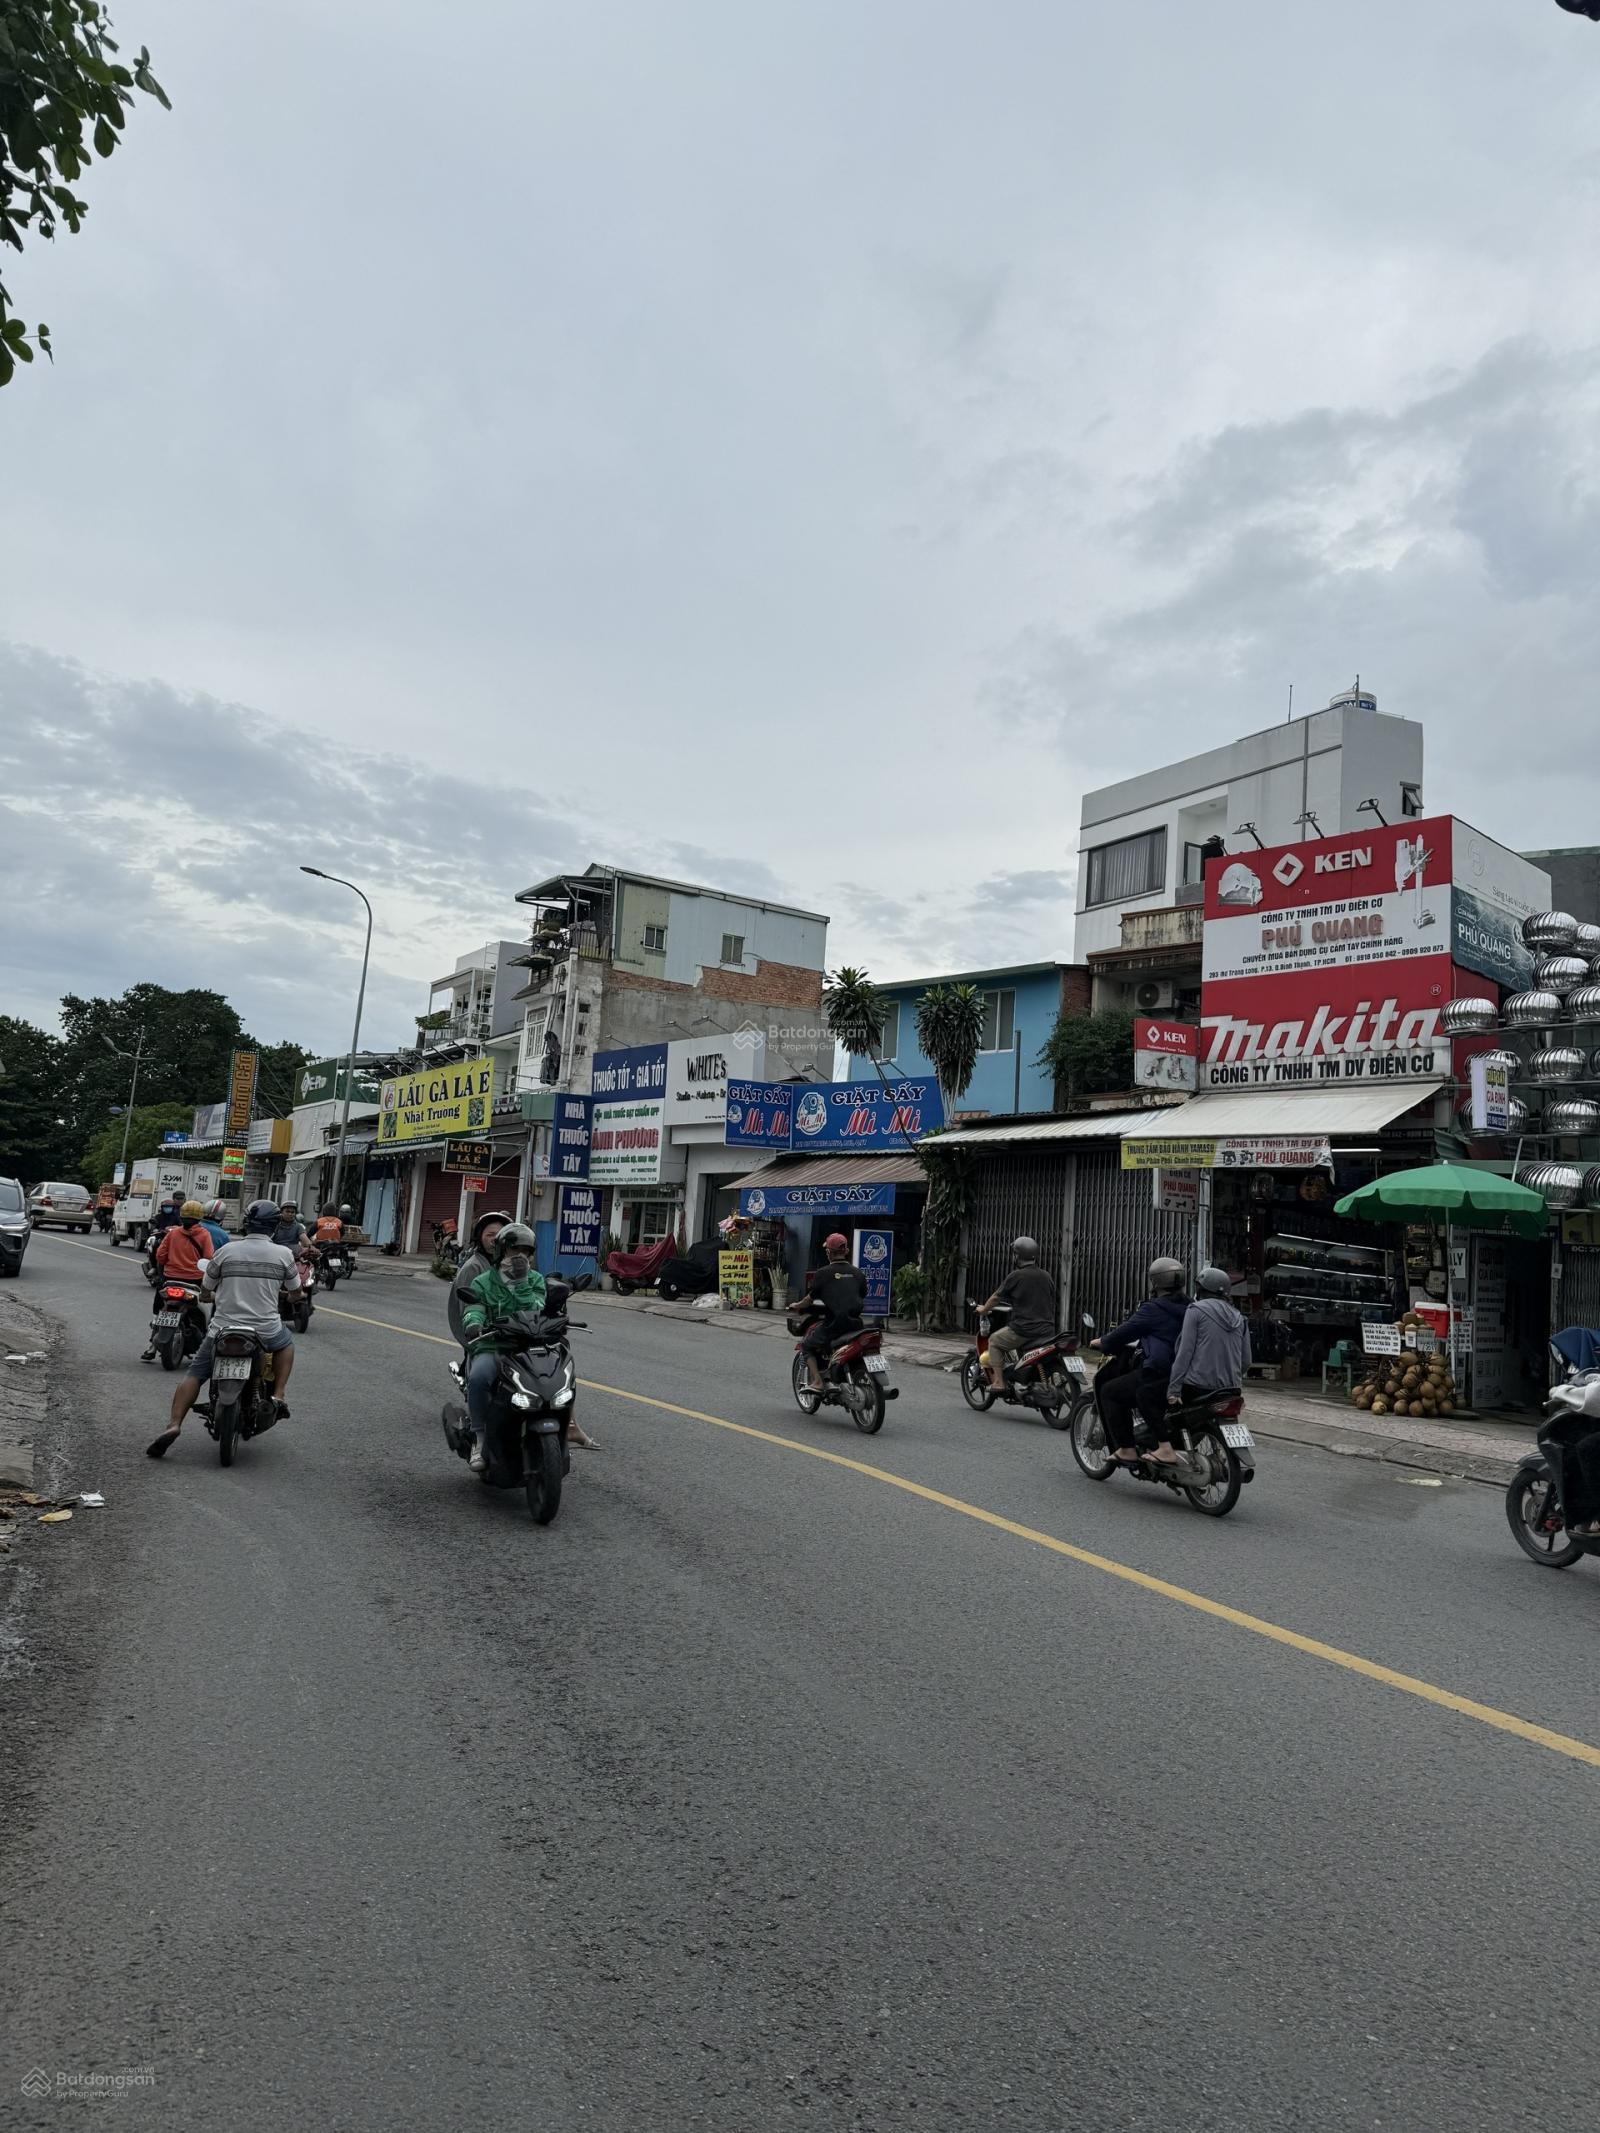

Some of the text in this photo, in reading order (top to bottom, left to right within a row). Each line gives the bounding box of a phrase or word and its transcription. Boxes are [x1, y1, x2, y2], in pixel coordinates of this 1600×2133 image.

[1314, 847, 1372, 875] KEN
[1261, 912, 1283, 924] CÔNG
[1285, 910, 1295, 921] TY
[1297, 907, 1318, 919] TNHH
[1320, 905, 1333, 916] TM
[1335, 903, 1346, 914] DV
[1371, 897, 1383, 908] CƠ
[1311, 914, 1384, 944] QUANG
[1268, 951, 1284, 961] MUA
[1347, 941, 1360, 951] TAY
[1480, 932, 1512, 960] QUANG
[1164, 1031, 1187, 1044] KEN
[594, 1062, 616, 1092] THUỐC
[618, 1060, 630, 1090] TỐT
[636, 1060, 649, 1088] GIÁ
[651, 1056, 665, 1087] TỐT
[1210, 1052, 1434, 1084] CÔNG TY TNHH TM DV ĐIỆN CƠ
[398, 1063, 491, 1108] LẨU GÀ LÁ É
[729, 1084, 790, 1105] GIẶT SẤY
[831, 1082, 926, 1107] GIẶT SẤY
[404, 1110, 424, 1125] Nhật
[564, 1100, 585, 1119] NHÀ
[840, 1106, 921, 1136] Mi Mi
[559, 1125, 589, 1146] THUỐC
[563, 1154, 581, 1172] TÂY
[1280, 1151, 1314, 1164] QUANG
[162, 1175, 182, 1183] SYM
[571, 1190, 594, 1207] NHÀ
[787, 1184, 875, 1205] GIẶT SẤY
[563, 1207, 600, 1225] THUỐC
[570, 1227, 591, 1244] TÂY
